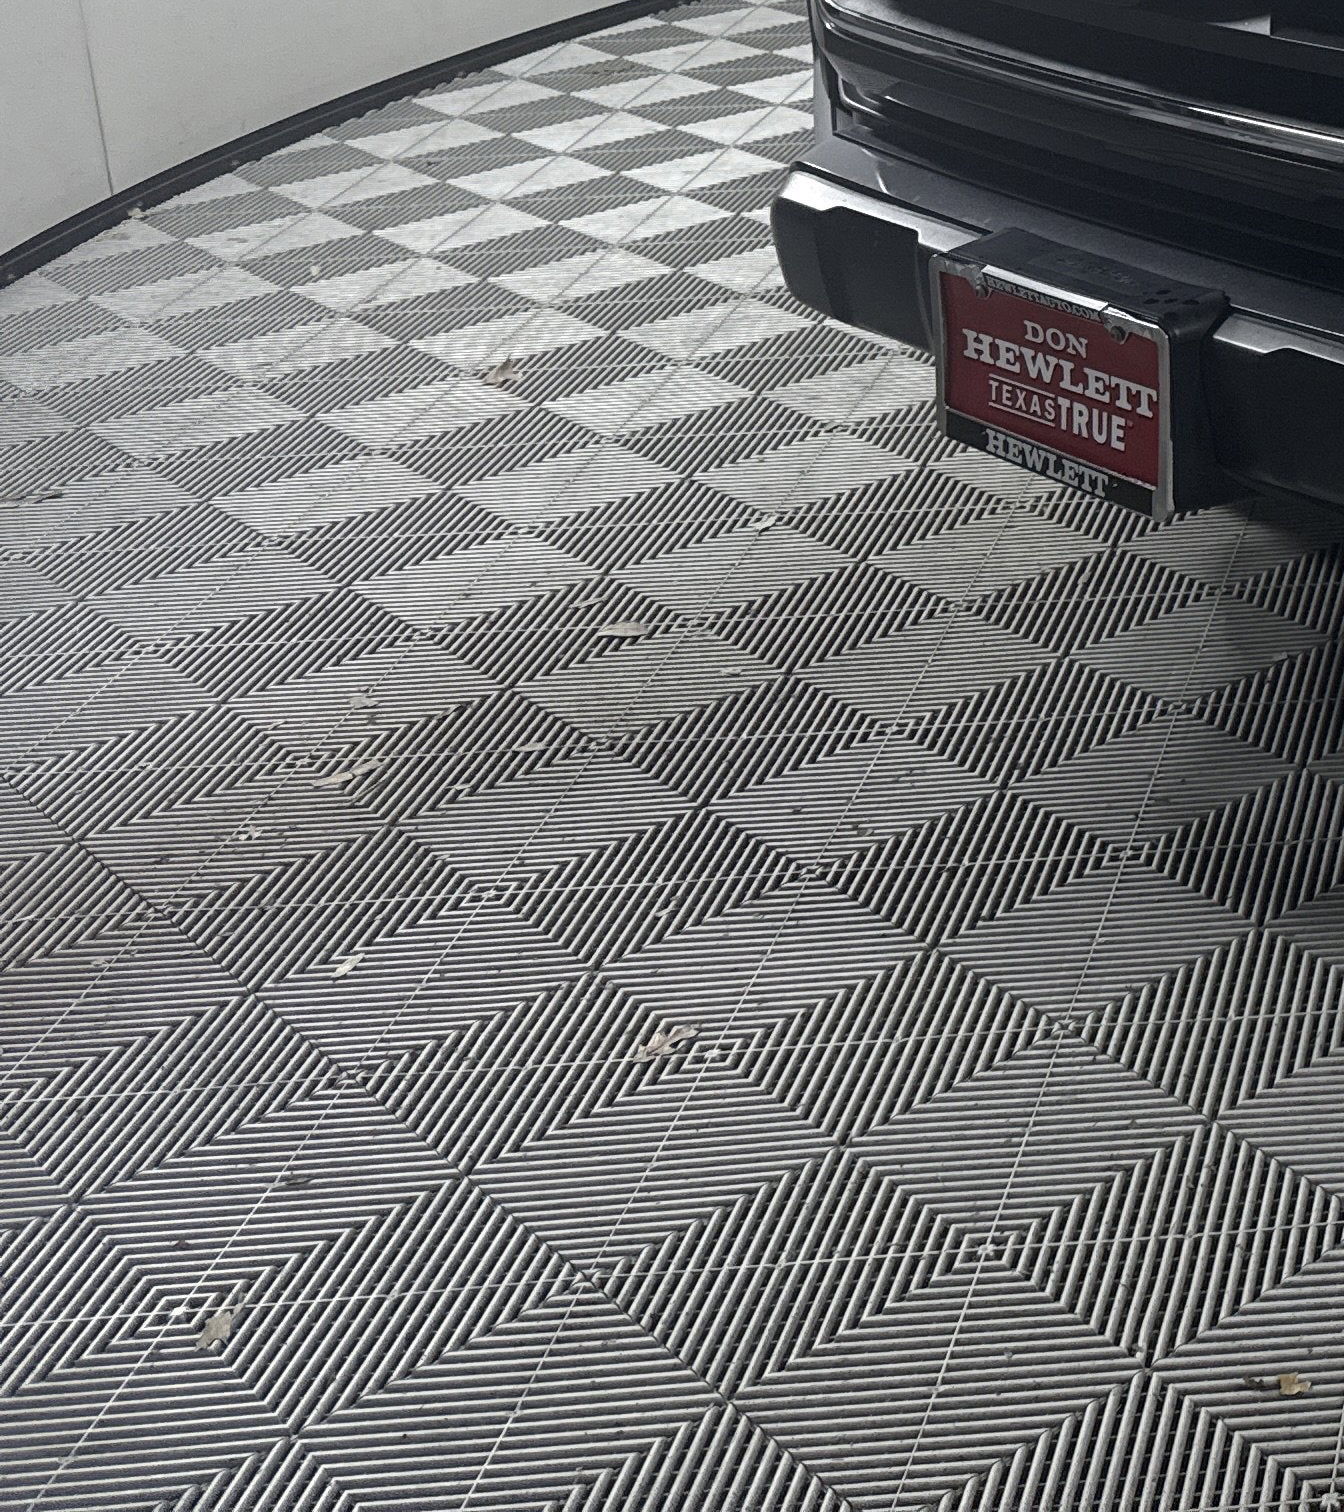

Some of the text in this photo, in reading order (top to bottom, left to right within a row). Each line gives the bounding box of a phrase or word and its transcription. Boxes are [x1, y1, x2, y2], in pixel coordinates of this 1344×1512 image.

[961, 328, 1158, 418] HEWLETT
[1023, 320, 1088, 359] DON
[985, 428, 1109, 498] HEWLETT
